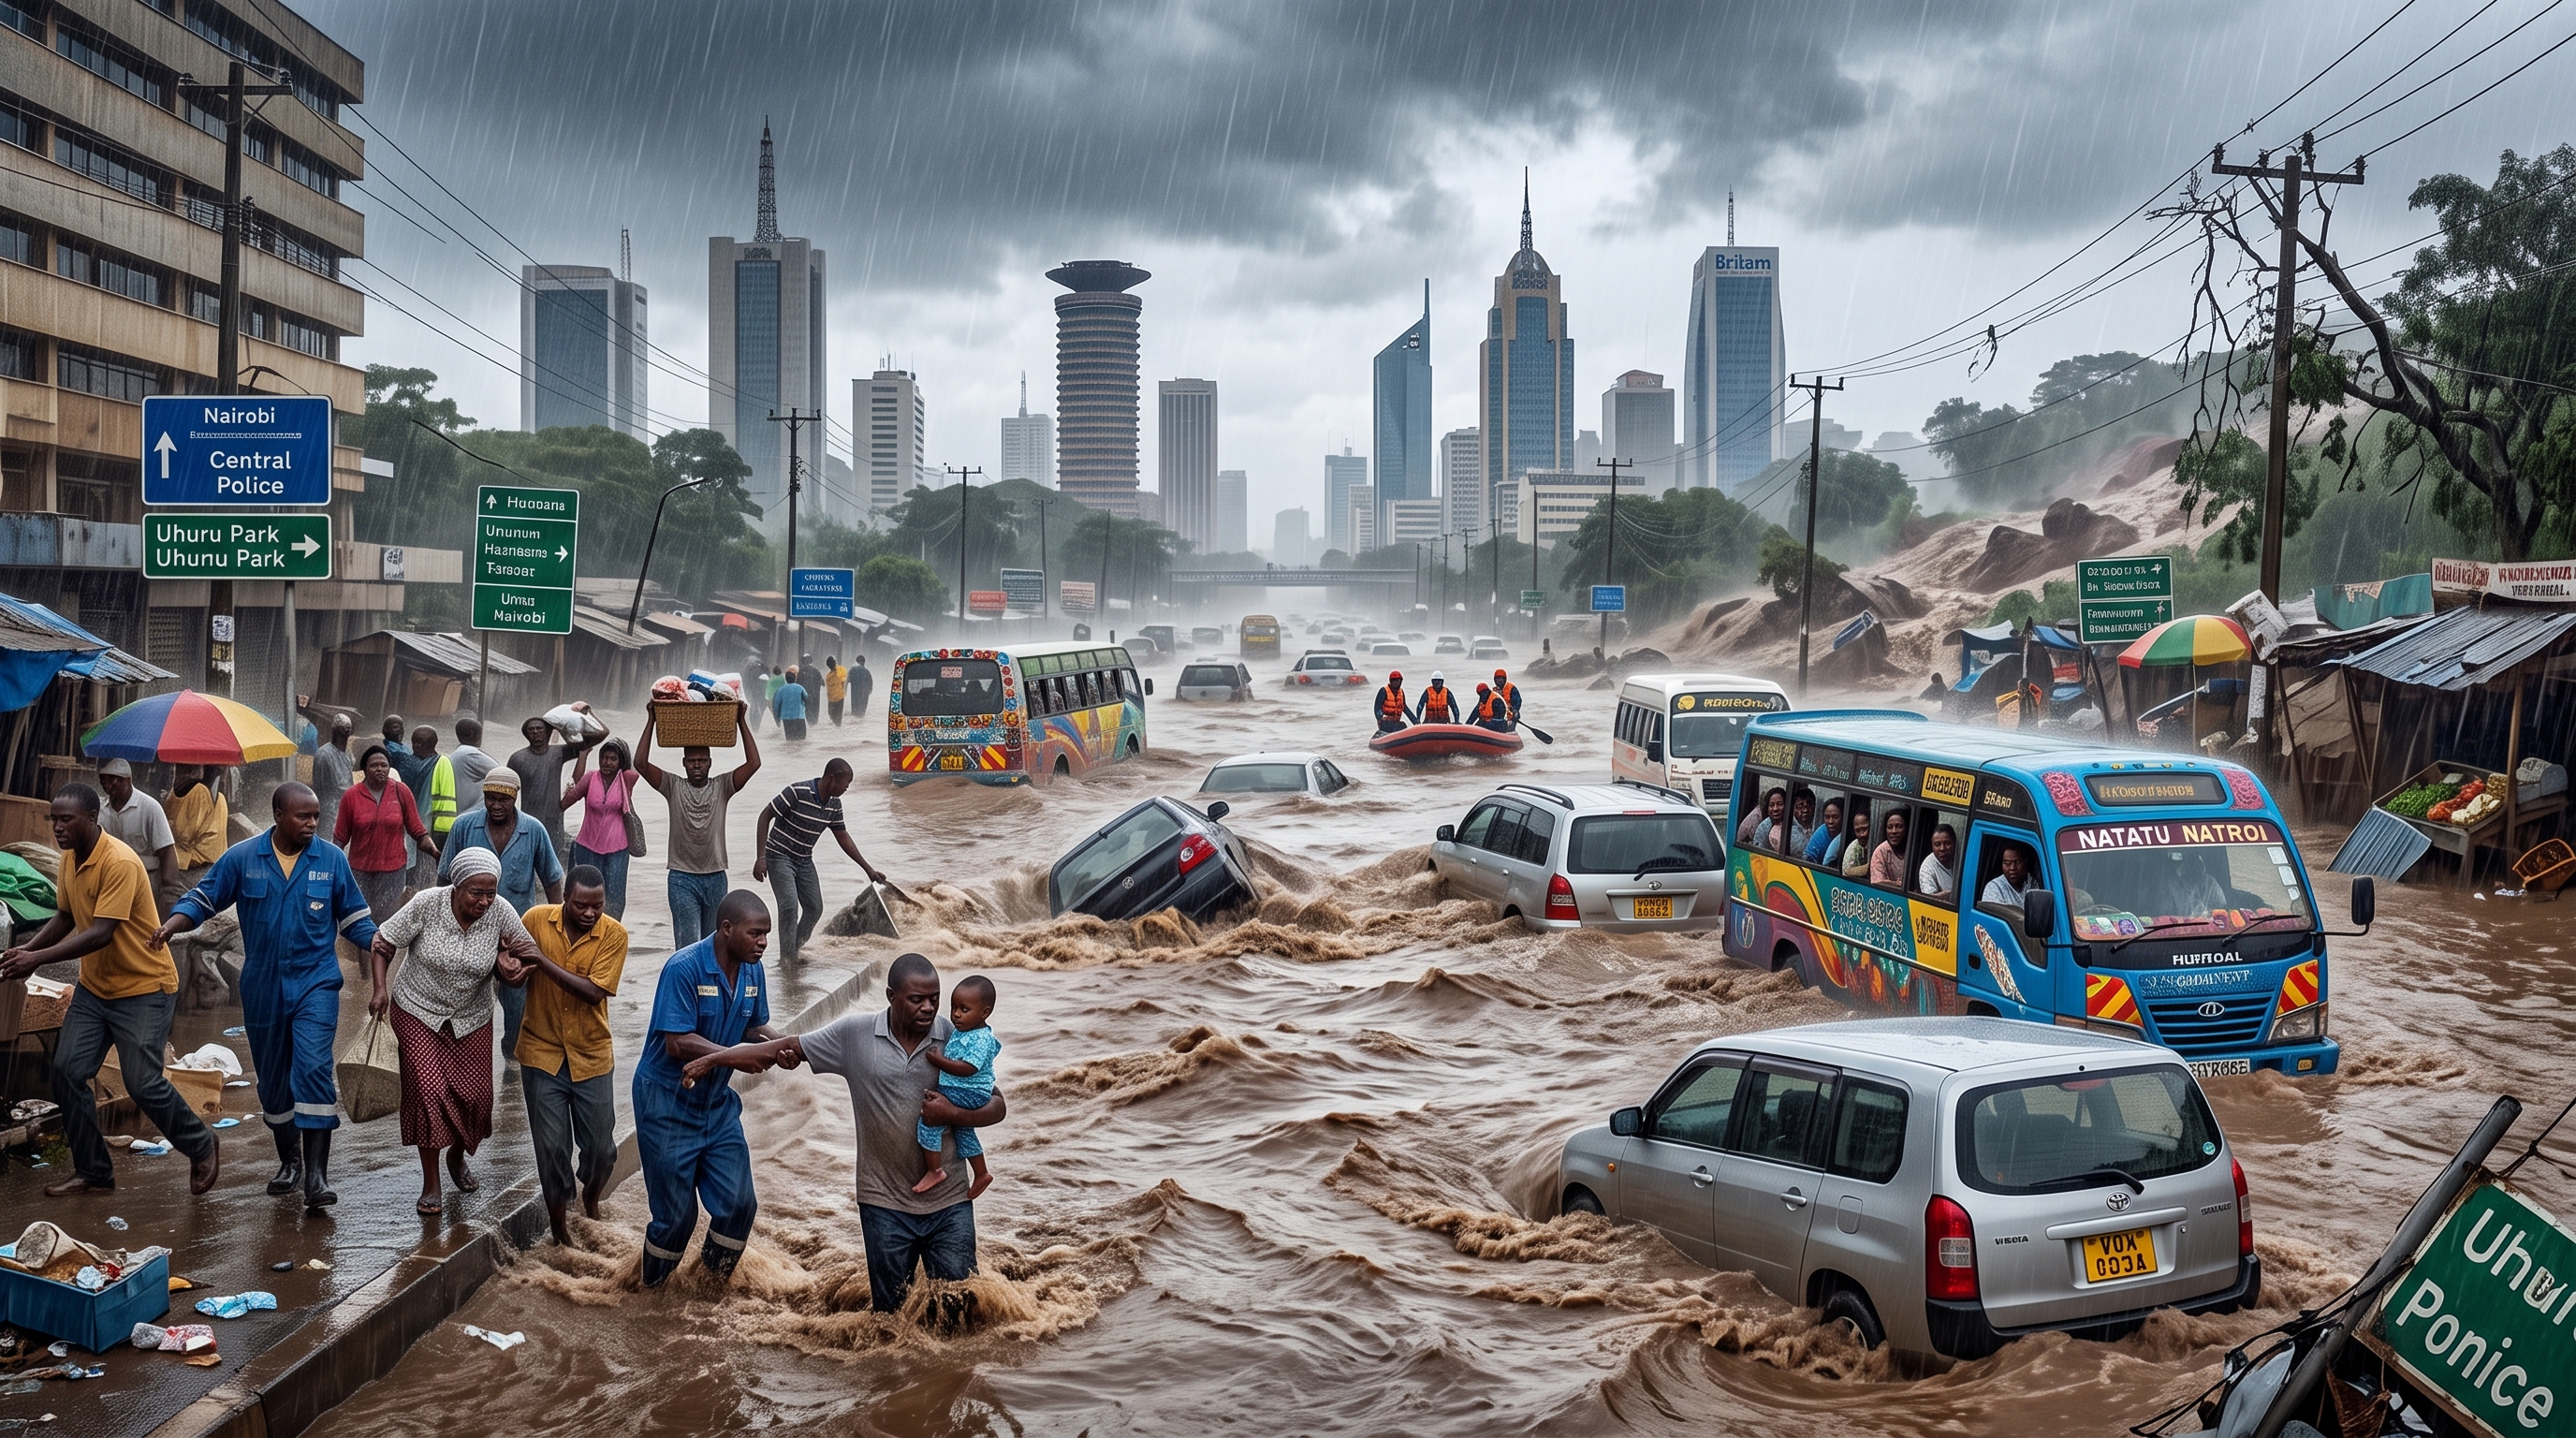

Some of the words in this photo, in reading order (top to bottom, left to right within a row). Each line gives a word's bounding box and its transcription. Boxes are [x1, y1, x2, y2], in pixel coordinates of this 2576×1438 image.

[1716, 254, 1771, 270] Britam
[204, 407, 275, 424] Nairobi
[210, 450, 291, 470] Central
[217, 476, 285, 494] Police
[156, 523, 222, 543] Uhuru
[230, 524, 280, 543] Park
[156, 548, 227, 567] Uhunu
[237, 549, 285, 567] Park
[2077, 825, 2171, 849] NATATU
[2181, 824, 2269, 843] NATROI
[2395, 1278, 2554, 1429] Ponice
